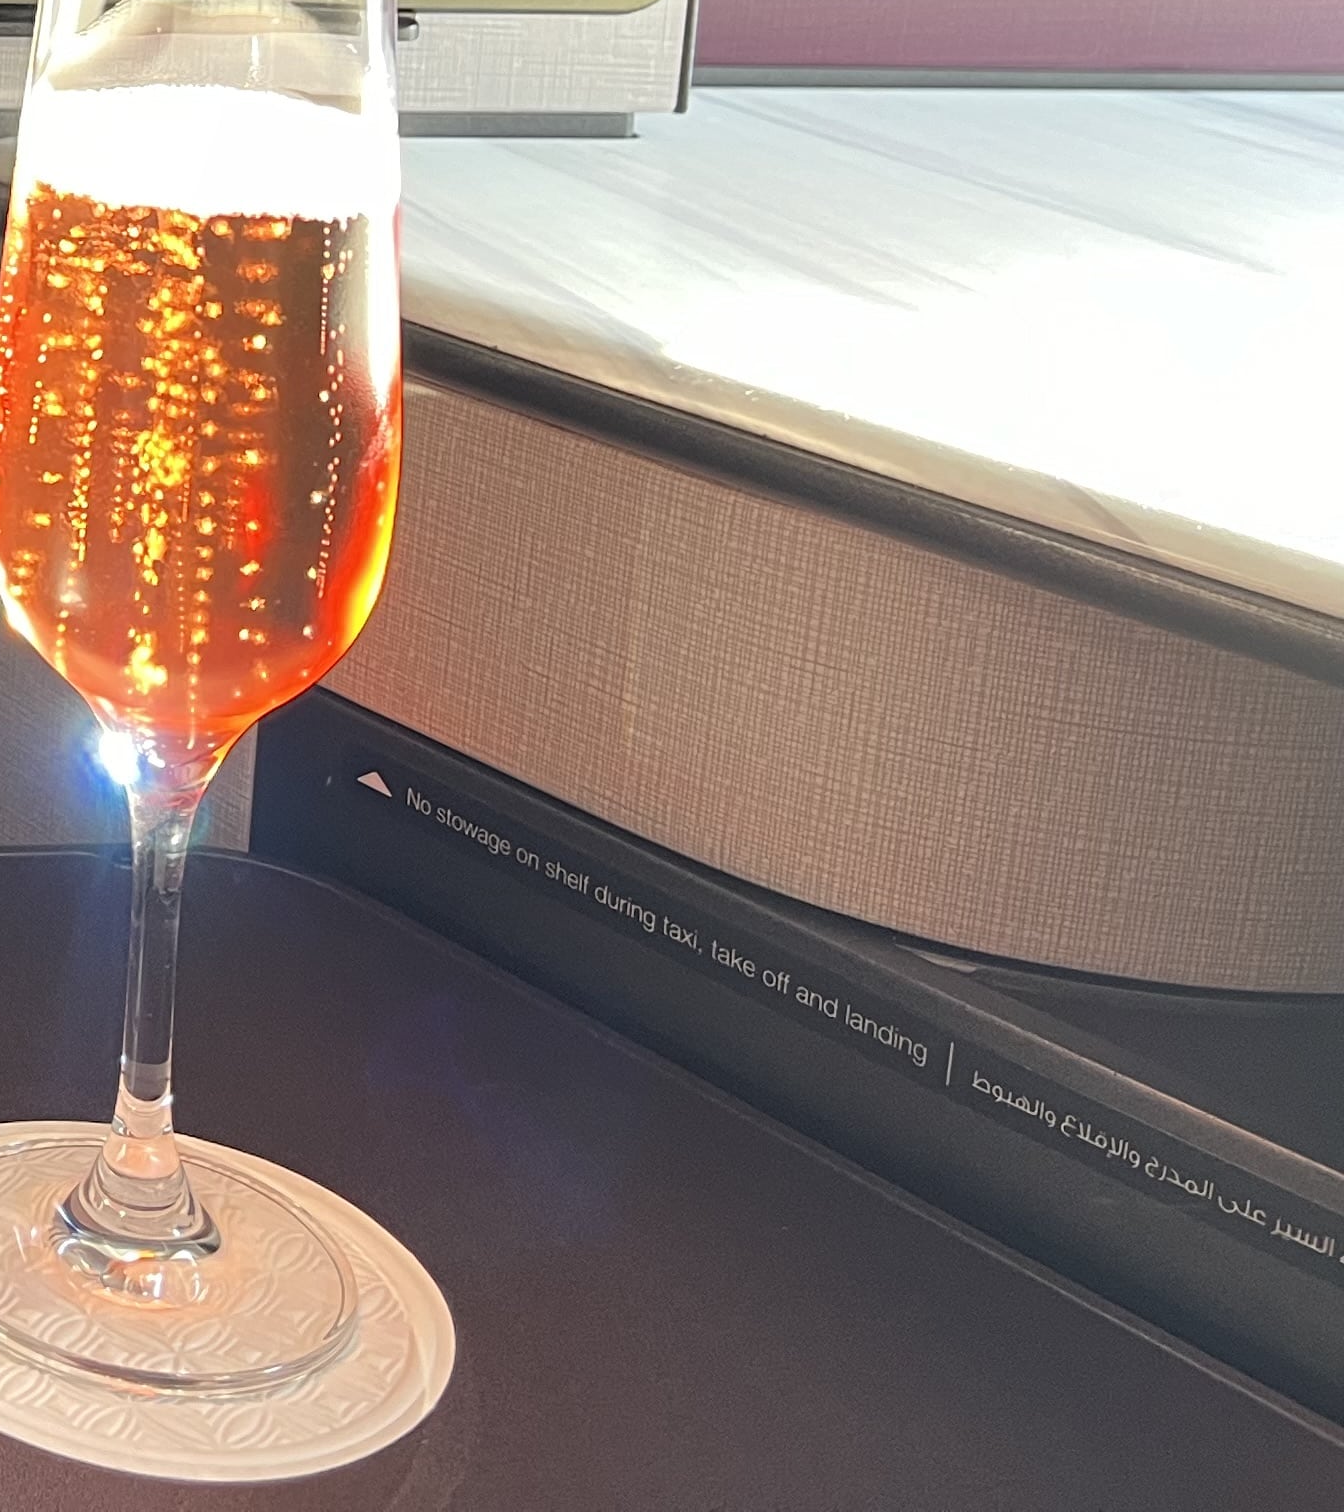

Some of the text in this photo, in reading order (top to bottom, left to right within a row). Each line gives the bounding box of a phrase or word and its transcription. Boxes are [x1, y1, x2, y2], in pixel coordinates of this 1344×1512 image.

[406, 787, 928, 1067] No stowage on shelf during taxi, take off and landing
[1218, 1195, 1267, 1225] على
